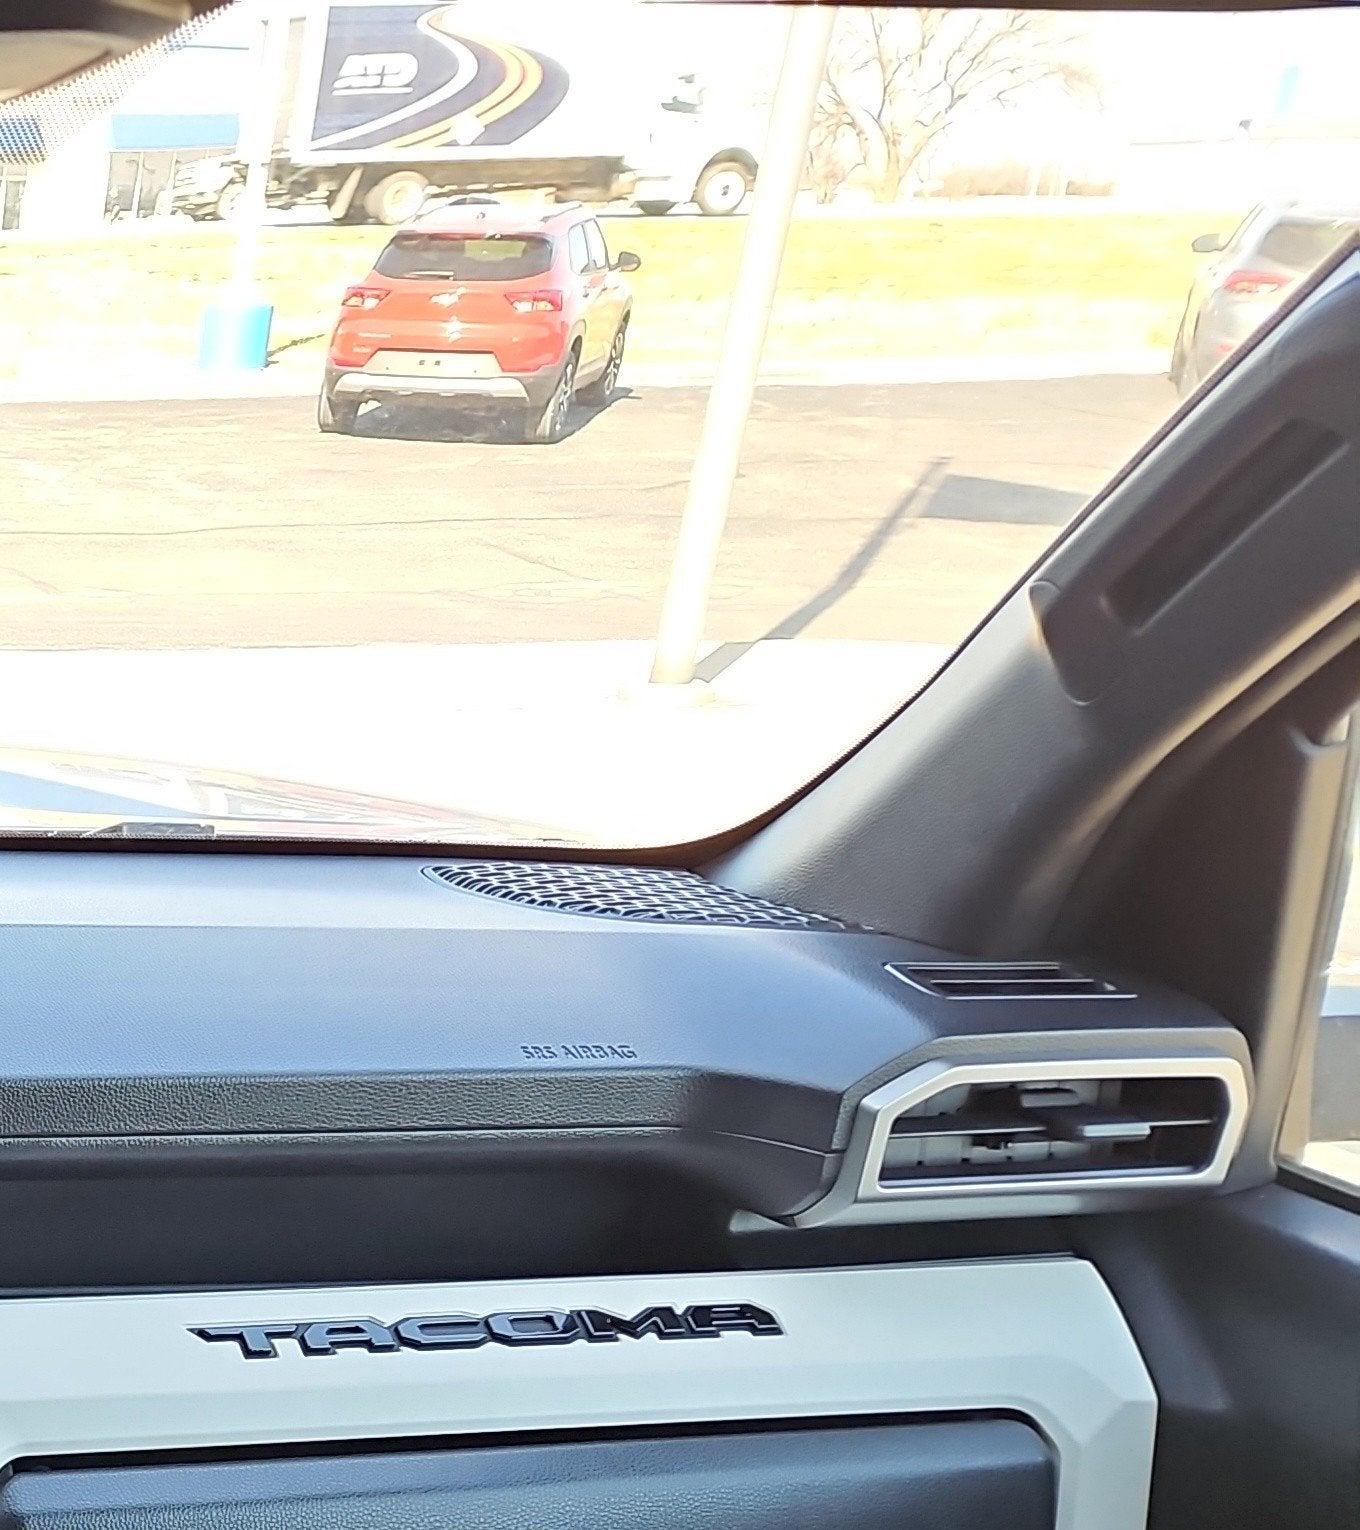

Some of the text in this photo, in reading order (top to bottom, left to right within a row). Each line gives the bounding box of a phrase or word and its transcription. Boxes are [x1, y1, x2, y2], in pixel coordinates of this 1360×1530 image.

[520, 1045, 638, 1059] SRS AIRBAG
[185, 1301, 787, 1360] TACOMA
